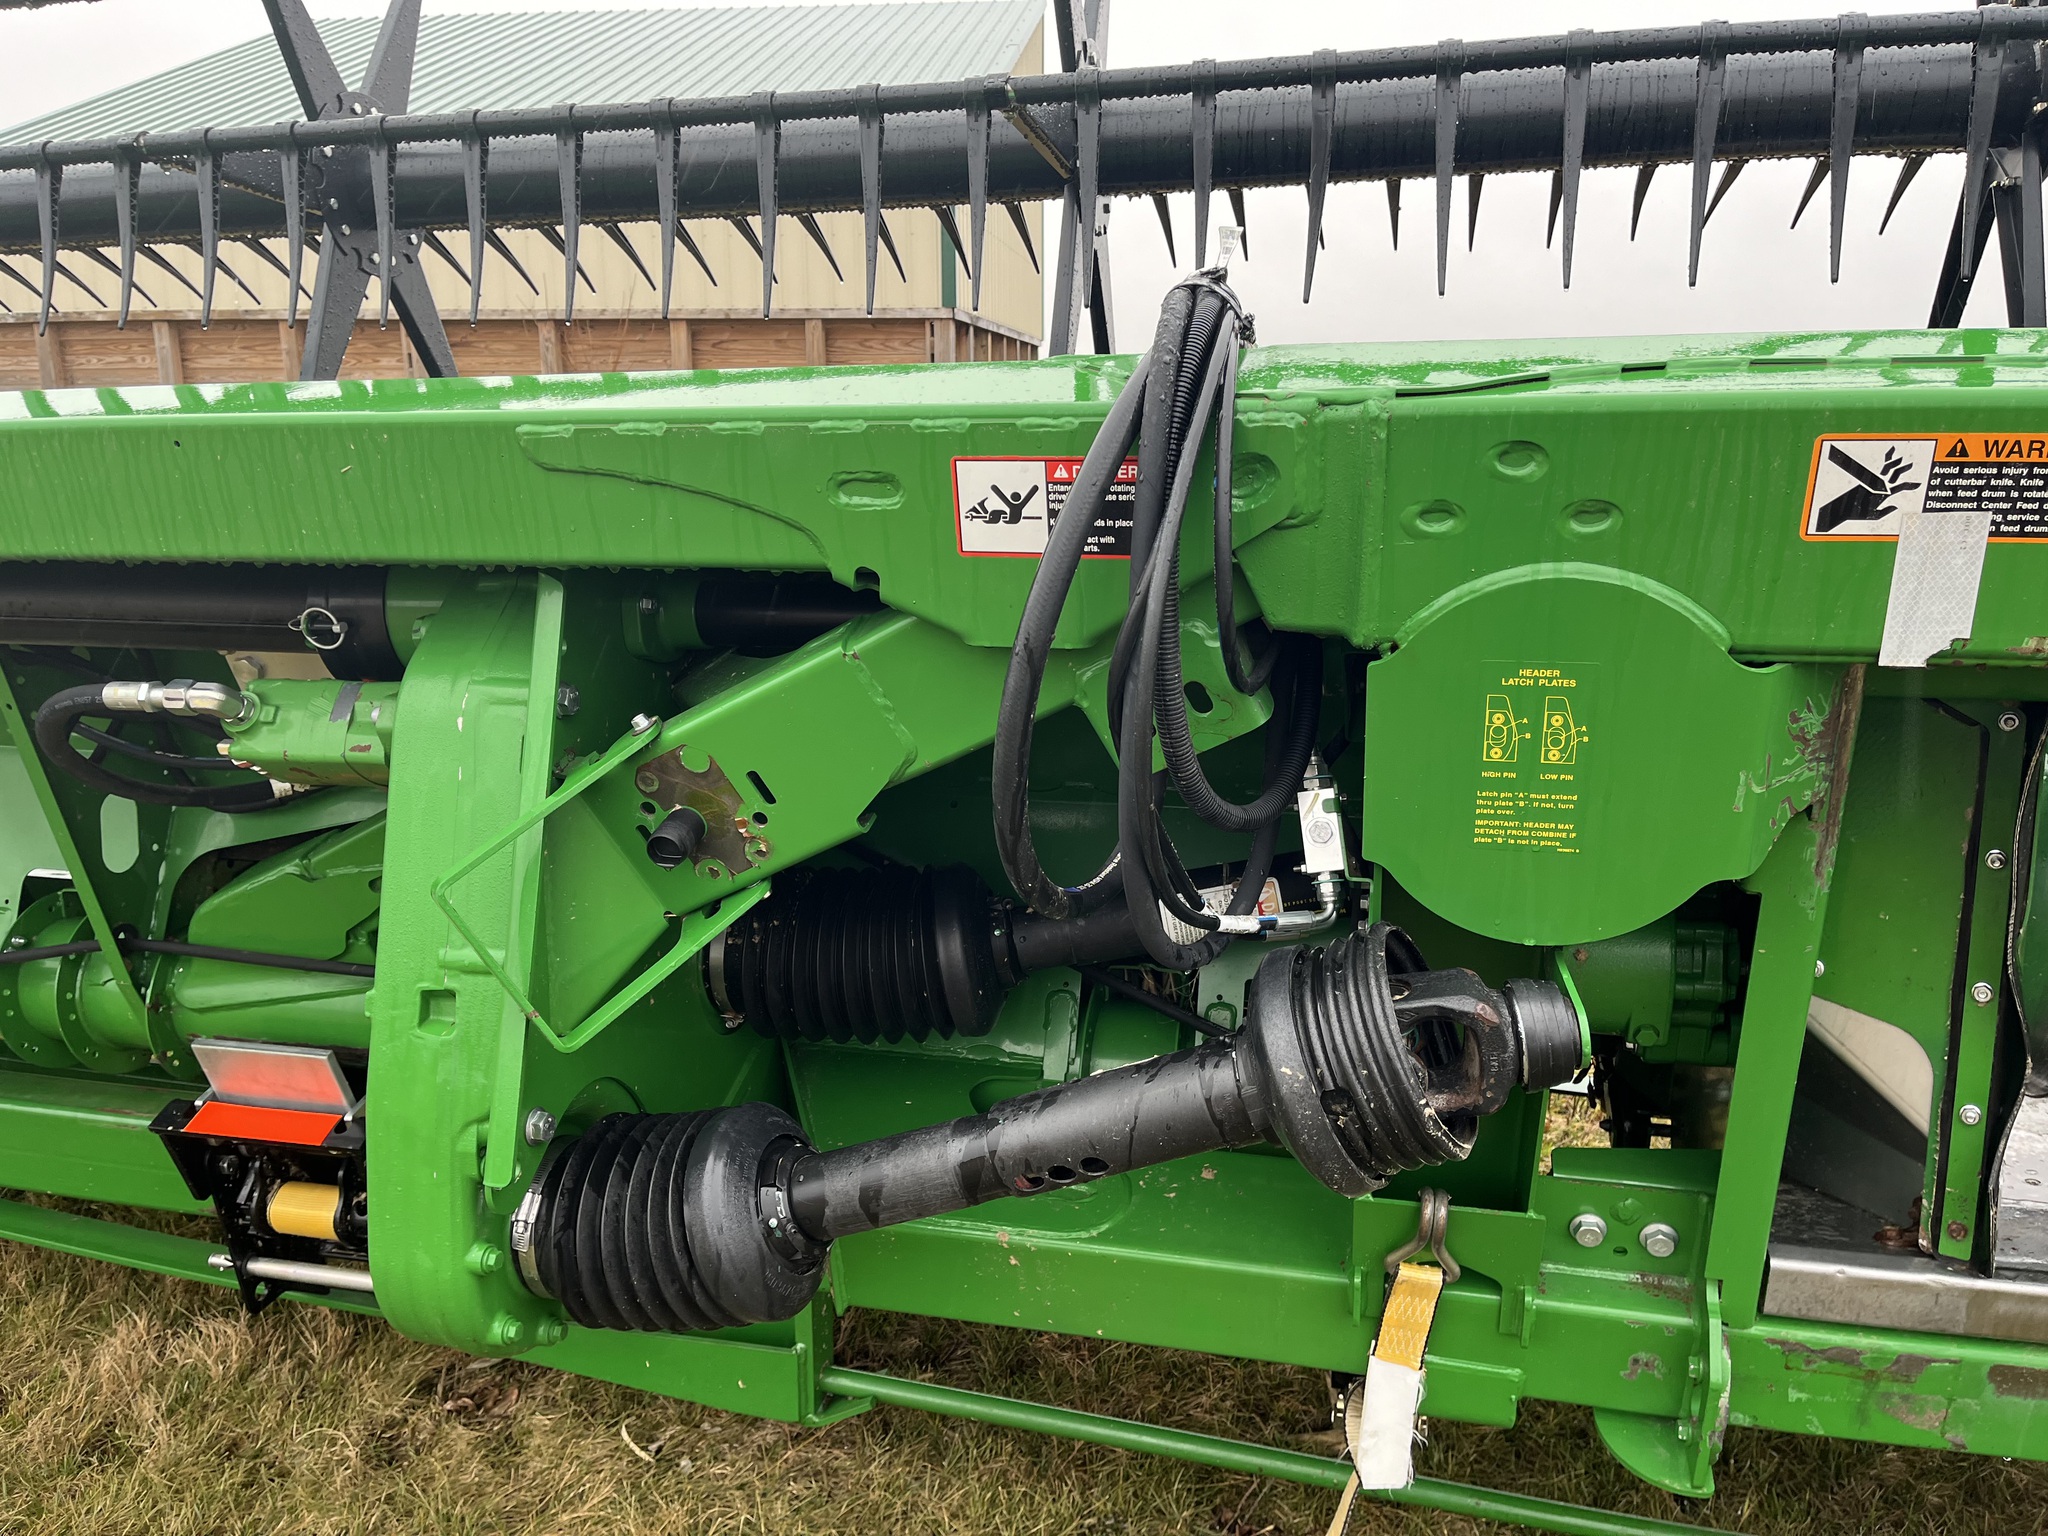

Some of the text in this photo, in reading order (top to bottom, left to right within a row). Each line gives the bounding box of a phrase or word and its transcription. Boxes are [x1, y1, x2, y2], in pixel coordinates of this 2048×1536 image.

[1984, 439, 2048, 458] WAR
[1933, 466, 1959, 474] Avoid
[2002, 466, 2029, 476] injury
[1930, 478, 1941, 486] of
[1110, 484, 1136, 494] otating
[2010, 490, 2019, 498] is
[1926, 501, 1977, 509] Disconnect
[1982, 501, 2012, 509] Center
[2016, 501, 2039, 509] Feed
[2007, 512, 2040, 521] service
[1106, 519, 1113, 527] in
[2000, 524, 2020, 532] feed
[1099, 536, 1115, 544] with
[1519, 669, 1560, 677] HEADER
[1502, 678, 1576, 687] LATCH PLATES
